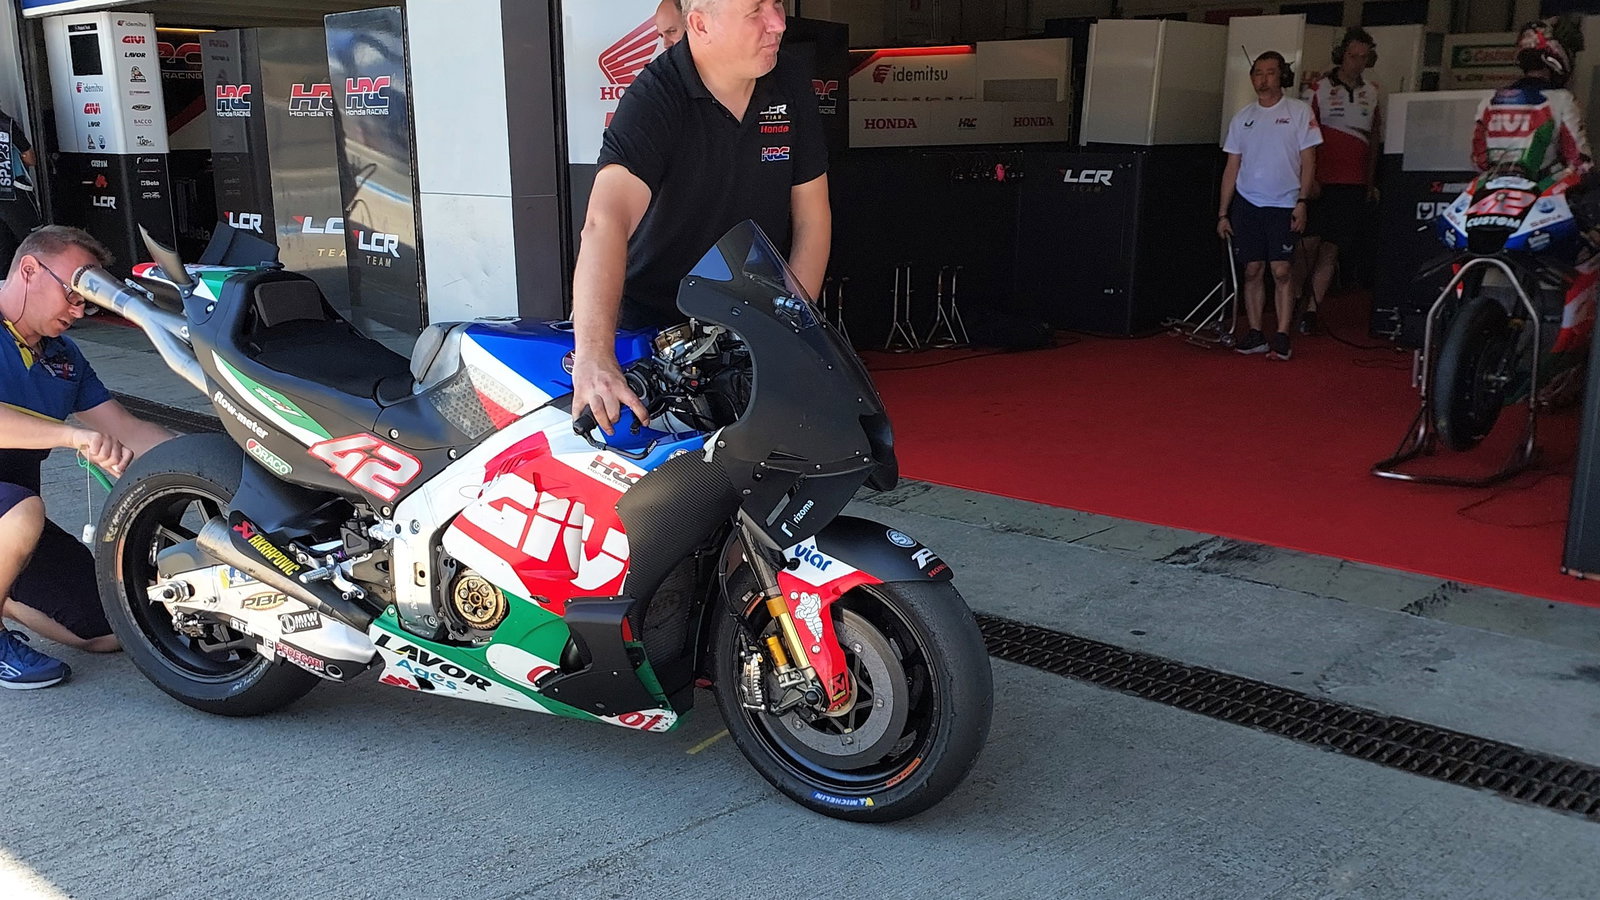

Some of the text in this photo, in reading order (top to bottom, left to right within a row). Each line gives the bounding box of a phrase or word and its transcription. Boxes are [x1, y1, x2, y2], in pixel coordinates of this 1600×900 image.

[122, 35, 146, 44] GIVI
[892, 65, 948, 82] idemitsu
[216, 84, 252, 111] HRC
[345, 76, 391, 109] HRC
[84, 102, 101, 114] GIVI
[760, 125, 789, 134] Honda
[864, 118, 918, 130] HONDA
[1013, 116, 1055, 128] HONDA
[761, 146, 790, 162] HRC
[1064, 169, 1114, 186] LCR
[93, 196, 117, 209] LCR
[229, 212, 263, 234] LCR
[301, 216, 345, 234] LC
[1467, 215, 1521, 228] CUSTOM
[358, 231, 401, 258] LCR
[366, 255, 392, 267] TEAM
[214, 390, 269, 439] flow-meter
[253, 446, 289, 474] DRACO
[308, 432, 422, 502] 42
[793, 499, 815, 524] rizoma
[462, 474, 629, 590] GIVI
[795, 543, 832, 572] viar
[240, 593, 288, 609] PBR
[295, 612, 318, 626] MIW
[374, 633, 493, 692] LAVOR
[814, 792, 858, 806] MICHELIN
